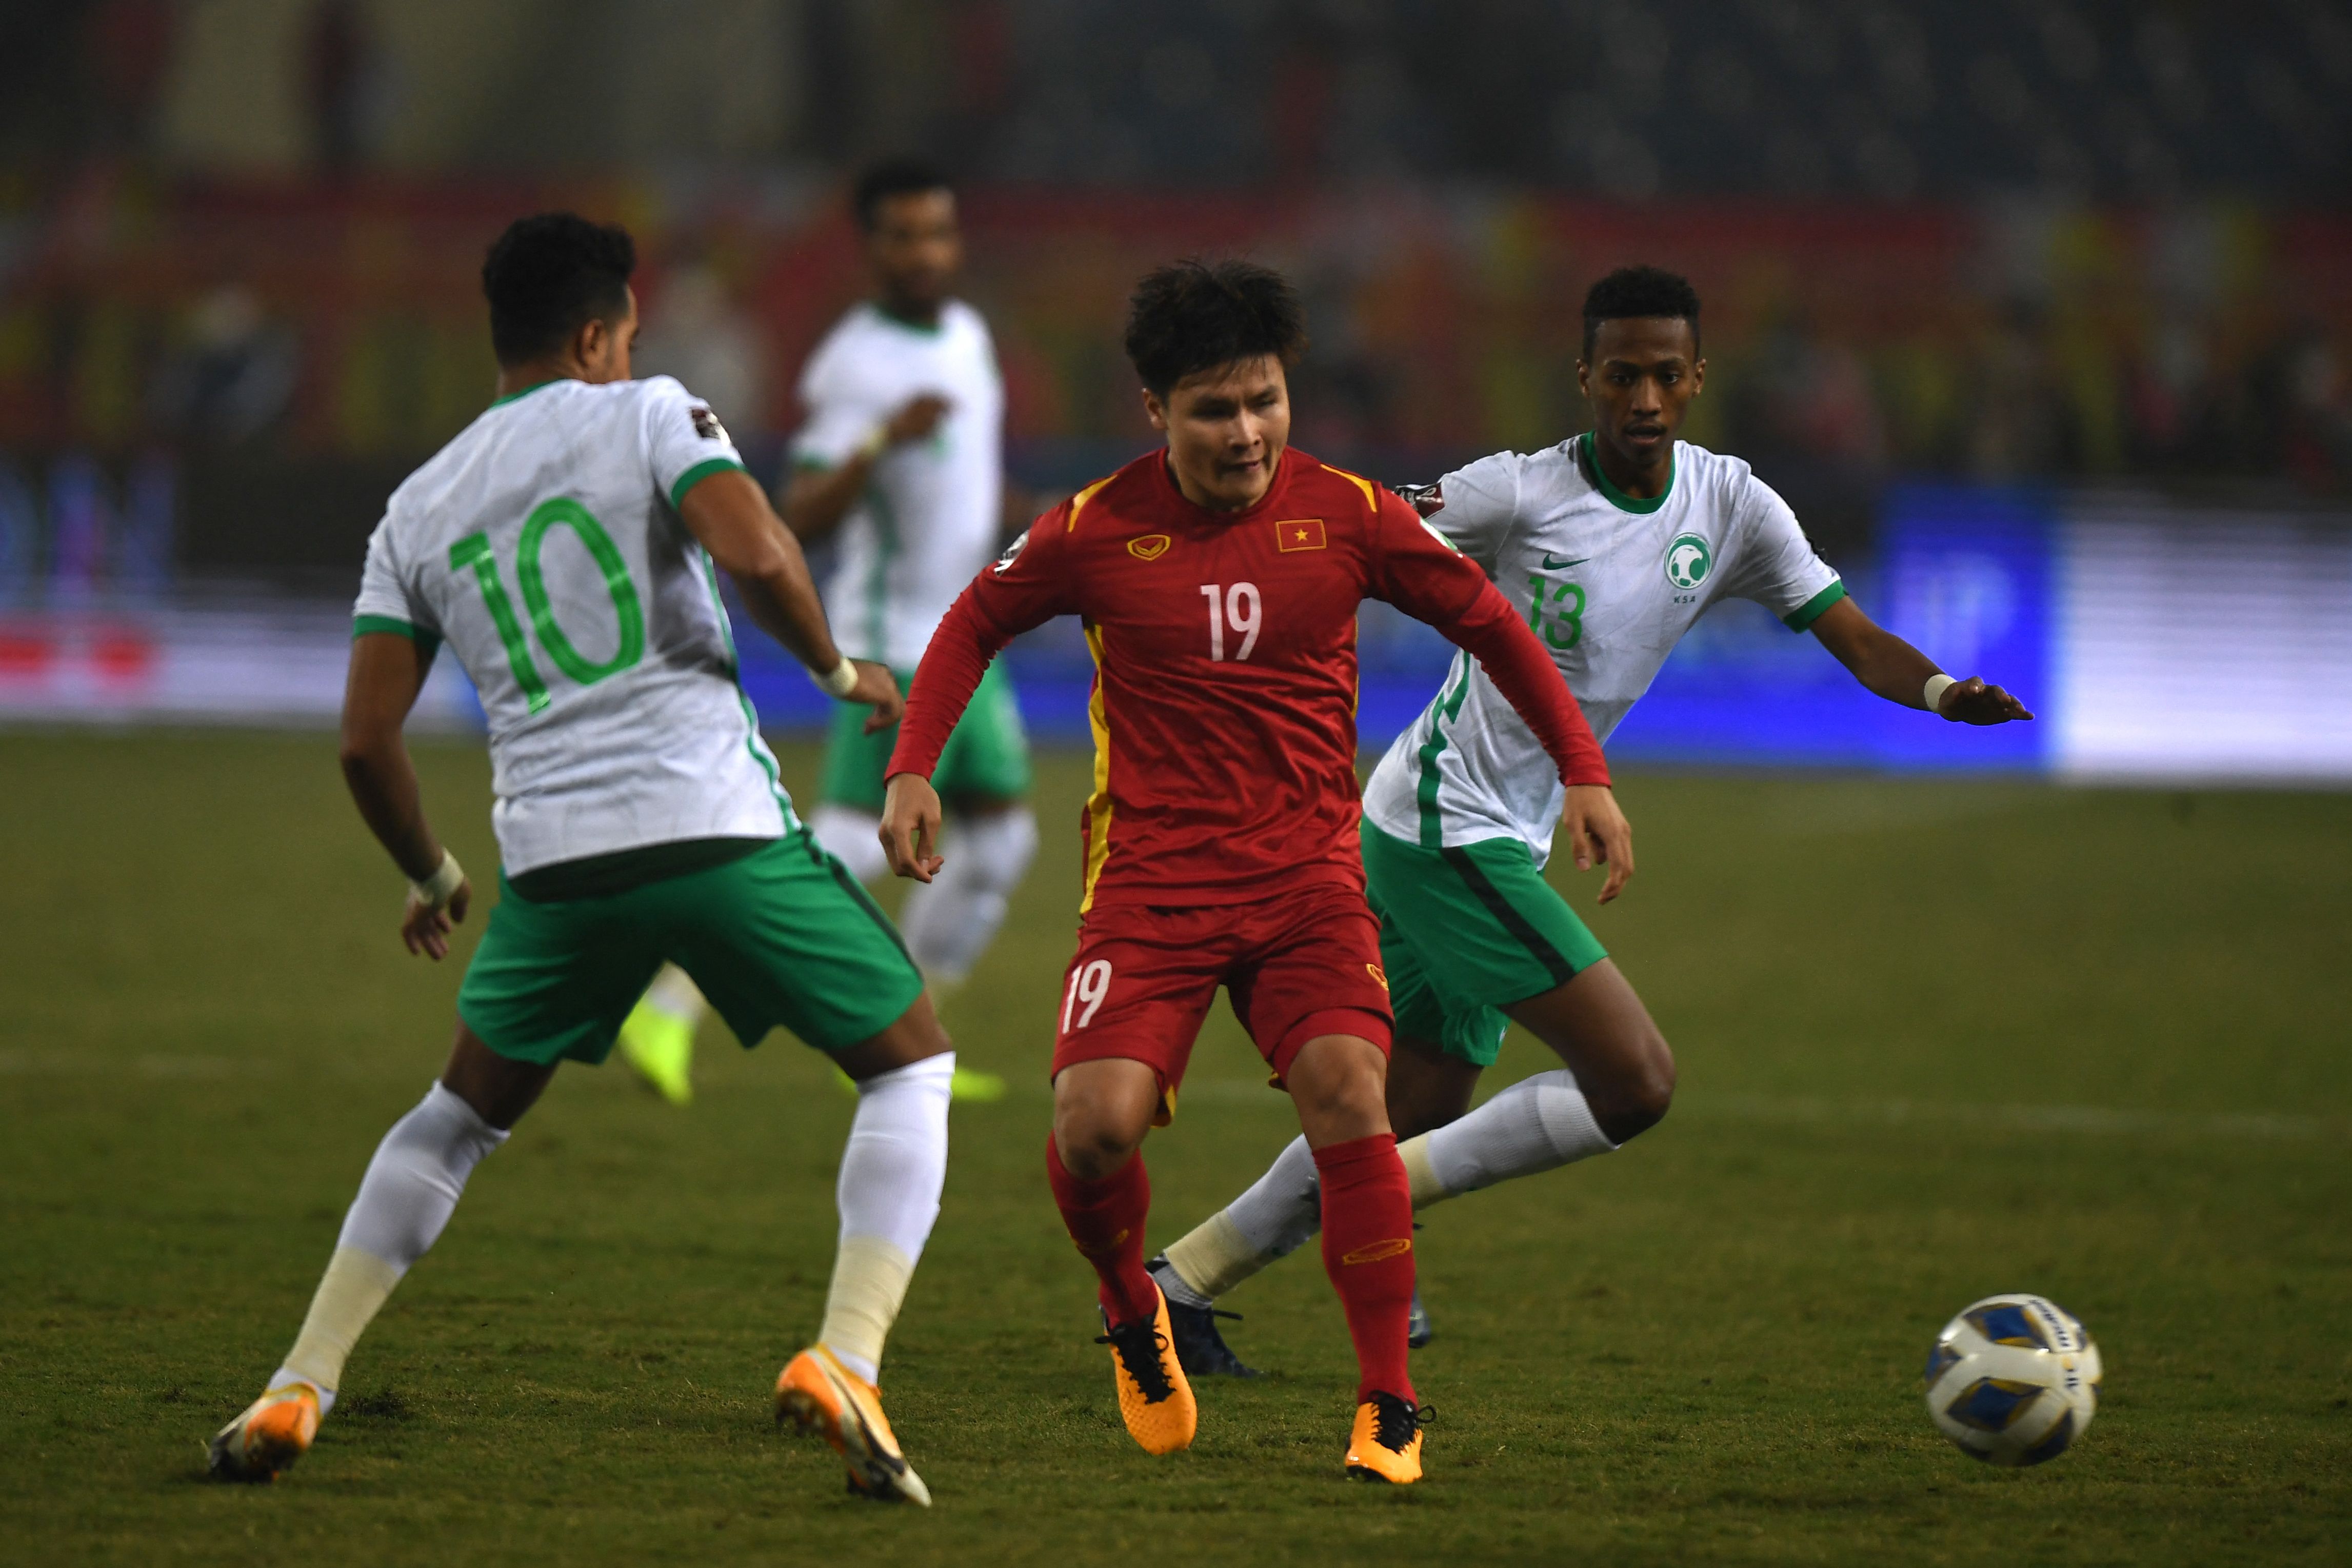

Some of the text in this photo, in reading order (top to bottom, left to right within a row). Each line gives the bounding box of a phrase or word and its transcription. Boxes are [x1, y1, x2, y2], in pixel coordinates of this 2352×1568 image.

[449, 496, 645, 715] 10
[1200, 581, 1262, 661] 19
[1528, 576, 1586, 650] 13
[1673, 595, 1697, 604] KSA
[1061, 958, 1113, 1034] 19
